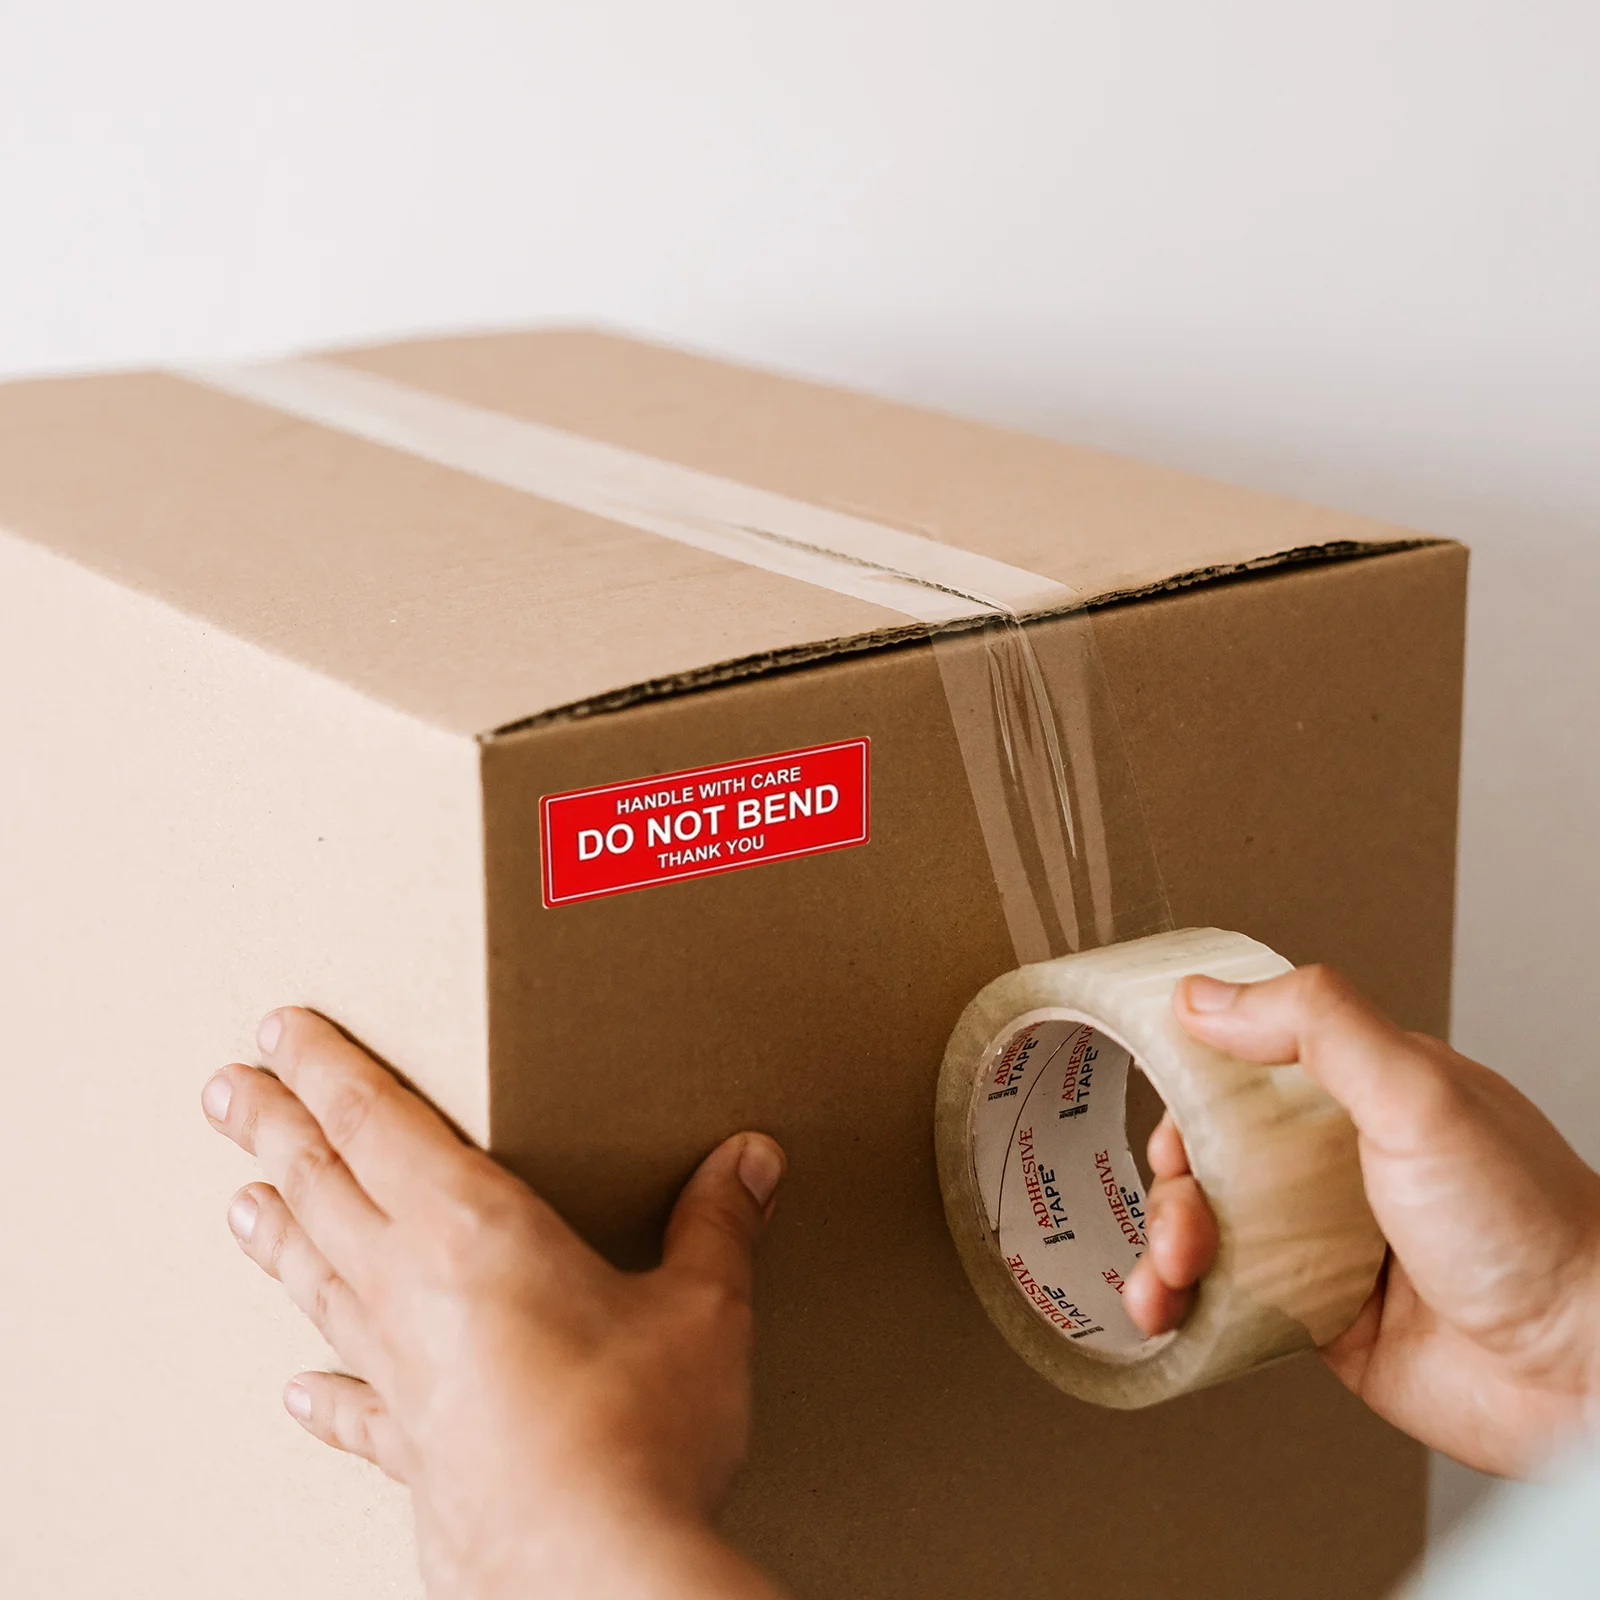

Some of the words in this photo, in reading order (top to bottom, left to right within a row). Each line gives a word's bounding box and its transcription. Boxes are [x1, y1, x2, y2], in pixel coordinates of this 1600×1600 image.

[577, 823, 635, 861] DO
[646, 804, 726, 848] NOT
[736, 784, 840, 831] BEND
[617, 786, 694, 815] HANDLE
[698, 776, 746, 799] WITH
[750, 766, 802, 789] CARE
[657, 842, 722, 869] THANK
[725, 834, 766, 855] YOU
[1018, 1126, 1054, 1229] ADHESIVE
[1095, 1149, 1146, 1246] ADHESIVE
[1006, 1253, 1079, 1331] ADHESIVE
